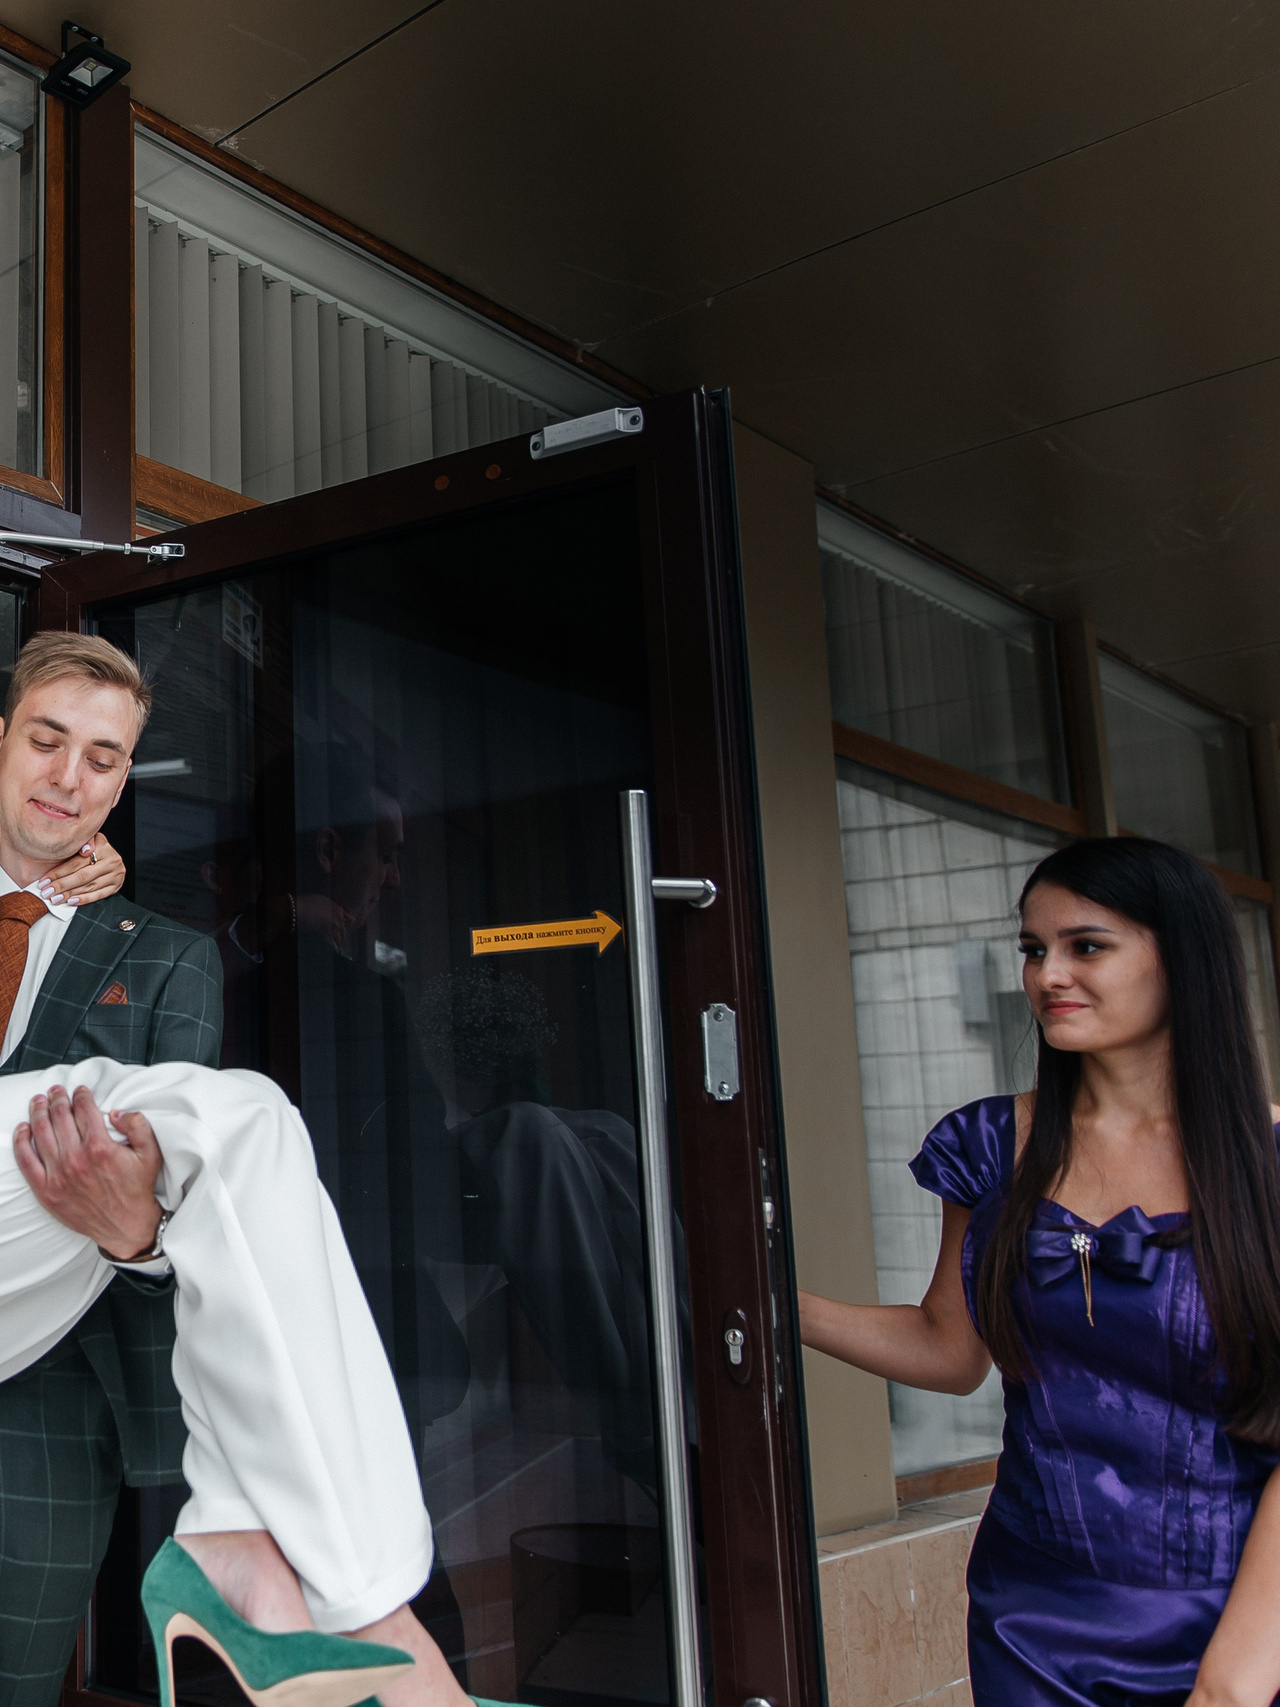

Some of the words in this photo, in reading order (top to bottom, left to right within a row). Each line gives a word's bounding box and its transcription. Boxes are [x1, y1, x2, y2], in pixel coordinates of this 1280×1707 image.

[476, 935, 492, 946] Для
[494, 931, 534, 943] выхода
[536, 928, 574, 939] нажмите
[575, 925, 607, 936] кнопку
